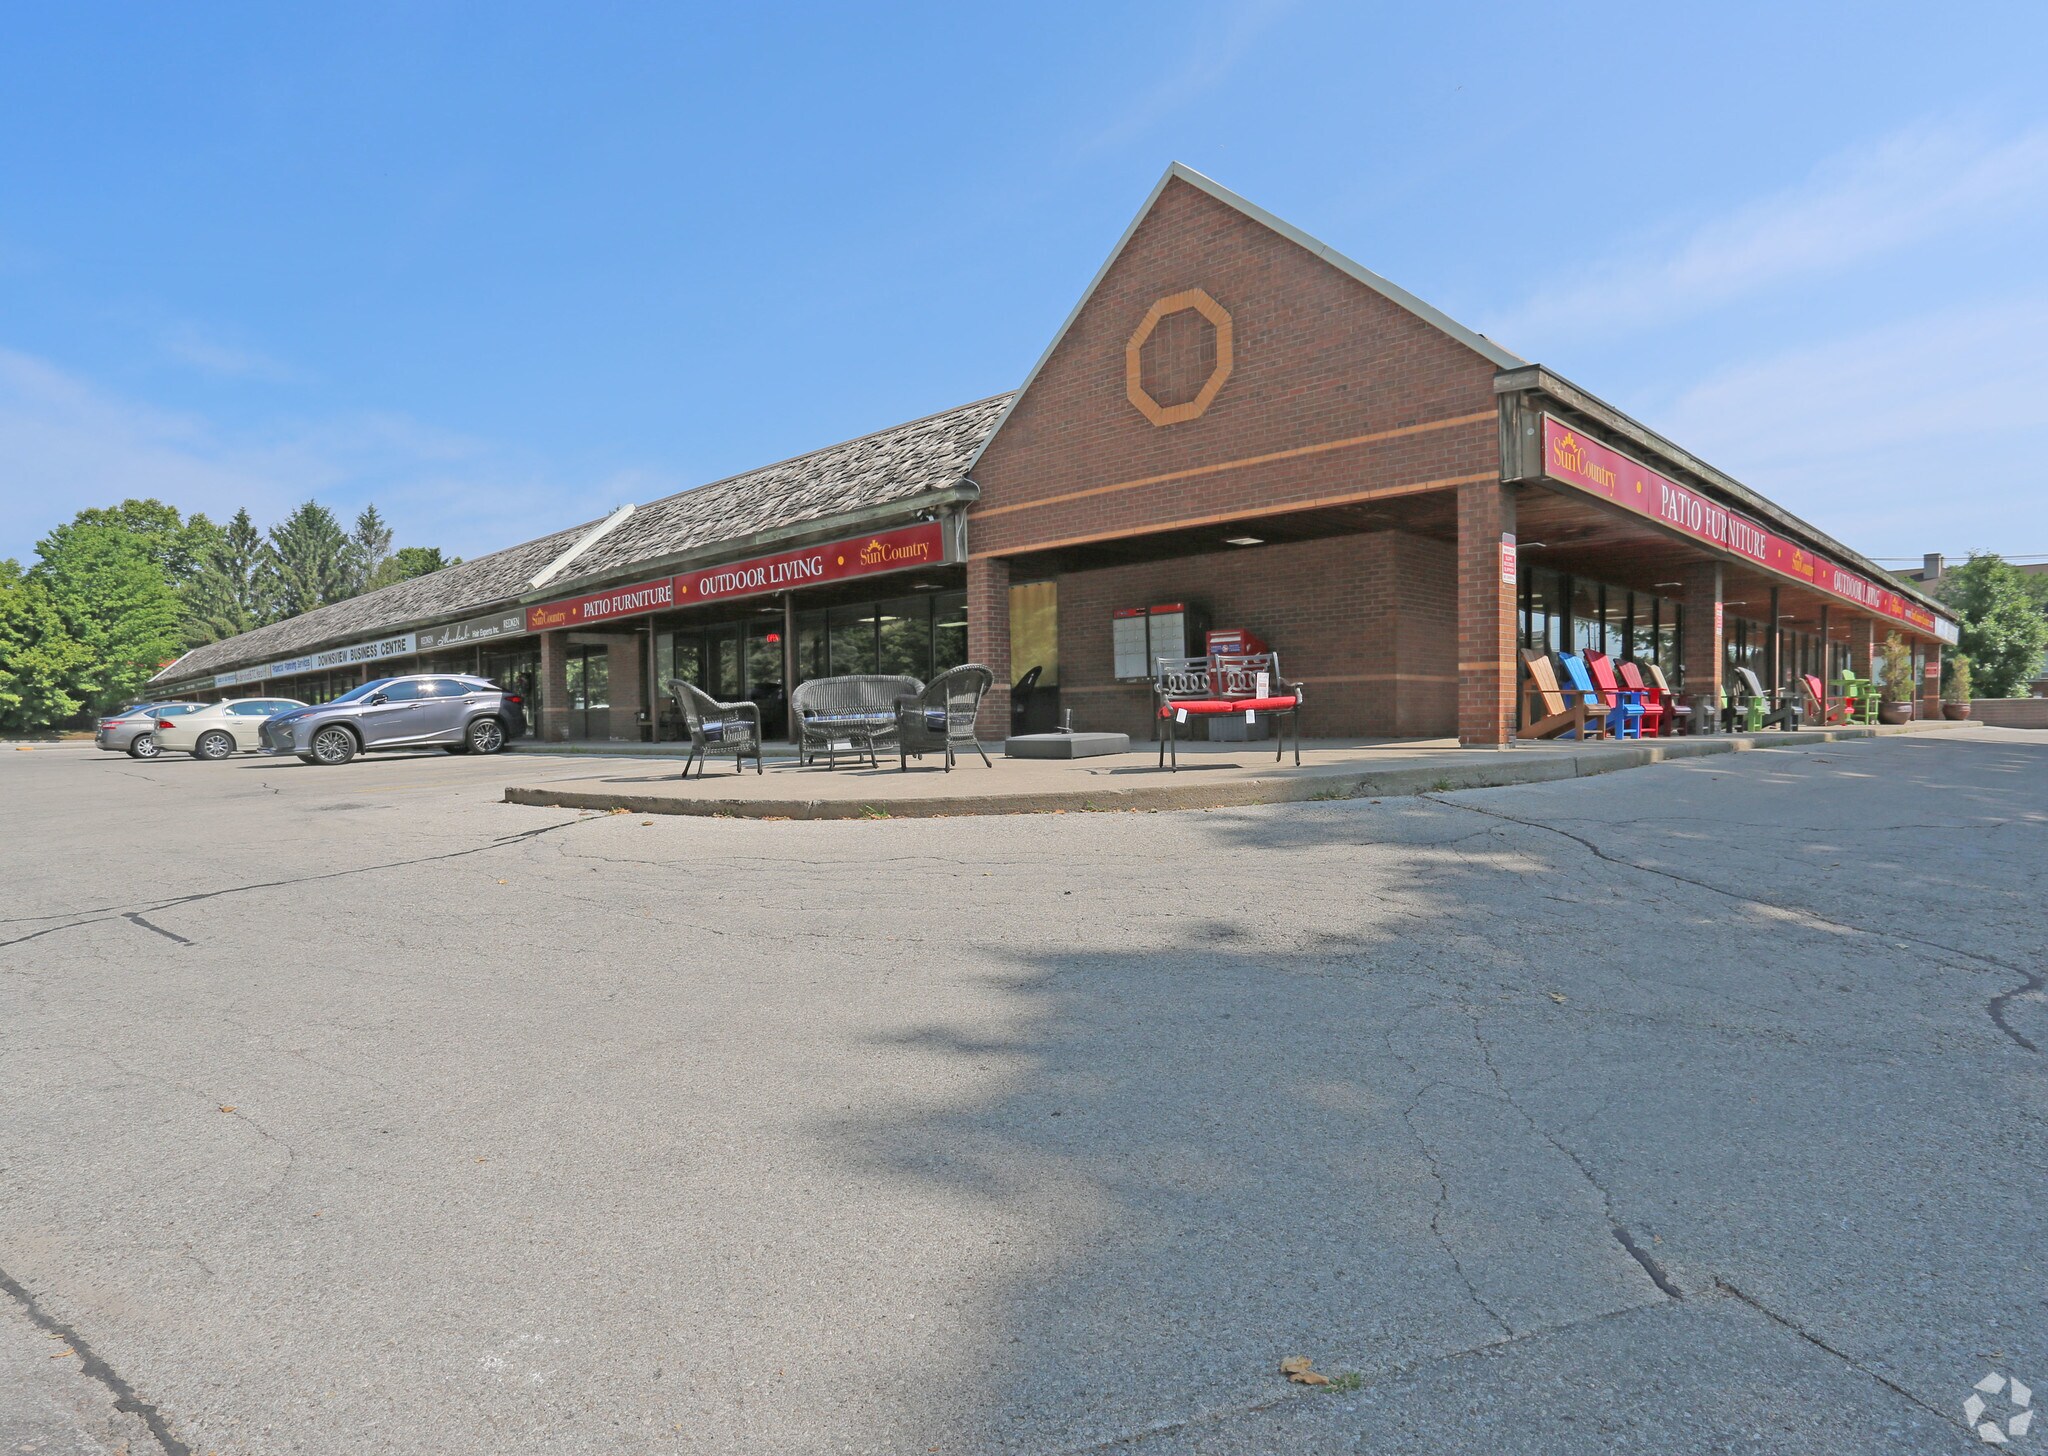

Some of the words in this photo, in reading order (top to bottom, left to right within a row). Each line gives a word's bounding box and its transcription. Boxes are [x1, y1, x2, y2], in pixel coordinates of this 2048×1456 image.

[1553, 434, 1576, 473] Sun
[1577, 448, 1616, 497] Country
[1661, 484, 1702, 532] PATIO
[1705, 506, 1766, 560] FURNITURE
[860, 545, 881, 566] Sun
[881, 541, 929, 562] Country
[700, 568, 766, 596] OUTDOOR
[770, 556, 823, 585] LIVING
[1834, 570, 1862, 601] OUTDOOR
[583, 599, 610, 618] PATIO
[612, 585, 672, 613] FURNITURE
[503, 617, 519, 628] REDKEN
[532, 613, 544, 626] Sun
[544, 612, 565, 625] Country
[318, 651, 347, 666] DOWNSVIEW
[350, 644, 377, 660] BUSINESS
[381, 638, 406, 654] CENTRE
